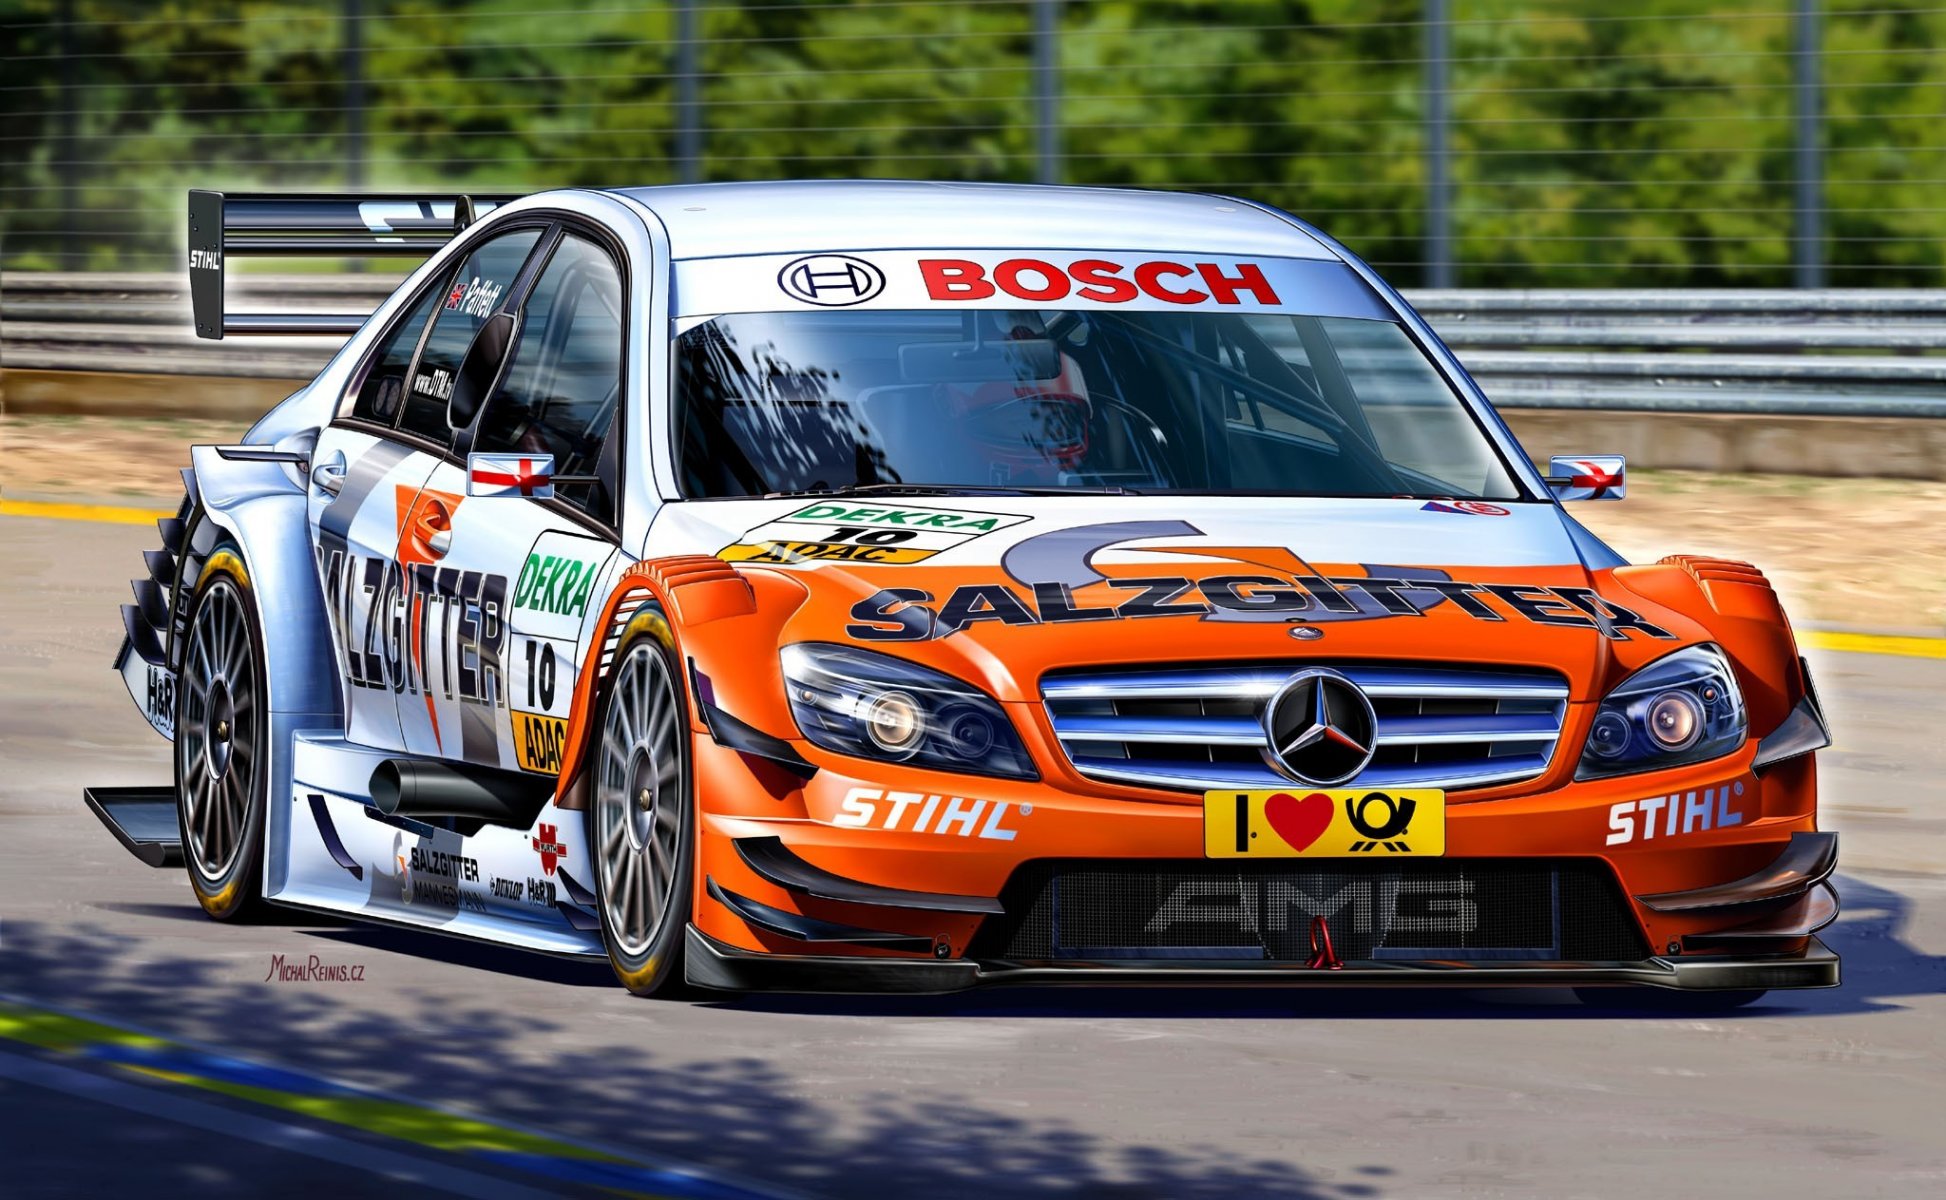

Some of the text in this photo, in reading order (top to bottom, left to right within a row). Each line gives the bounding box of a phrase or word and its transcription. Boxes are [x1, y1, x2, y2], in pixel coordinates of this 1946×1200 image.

[459, 276, 502, 319] Paffett
[917, 258, 1283, 306] BOSCH
[791, 505, 999, 531] DEKRA
[820, 527, 918, 545] 10
[746, 540, 898, 562] ADAC
[515, 553, 597, 617] DEKRA
[846, 574, 1678, 642] SALZGITTER
[525, 640, 556, 712] 10
[524, 716, 565, 772] ADAC
[1235, 794, 1249, 853] I
[411, 846, 479, 882] SALZGITTER
[413, 880, 487, 912] MANNESMANN
[494, 877, 524, 901] DUNLOP
[1144, 879, 1478, 934] AMG
